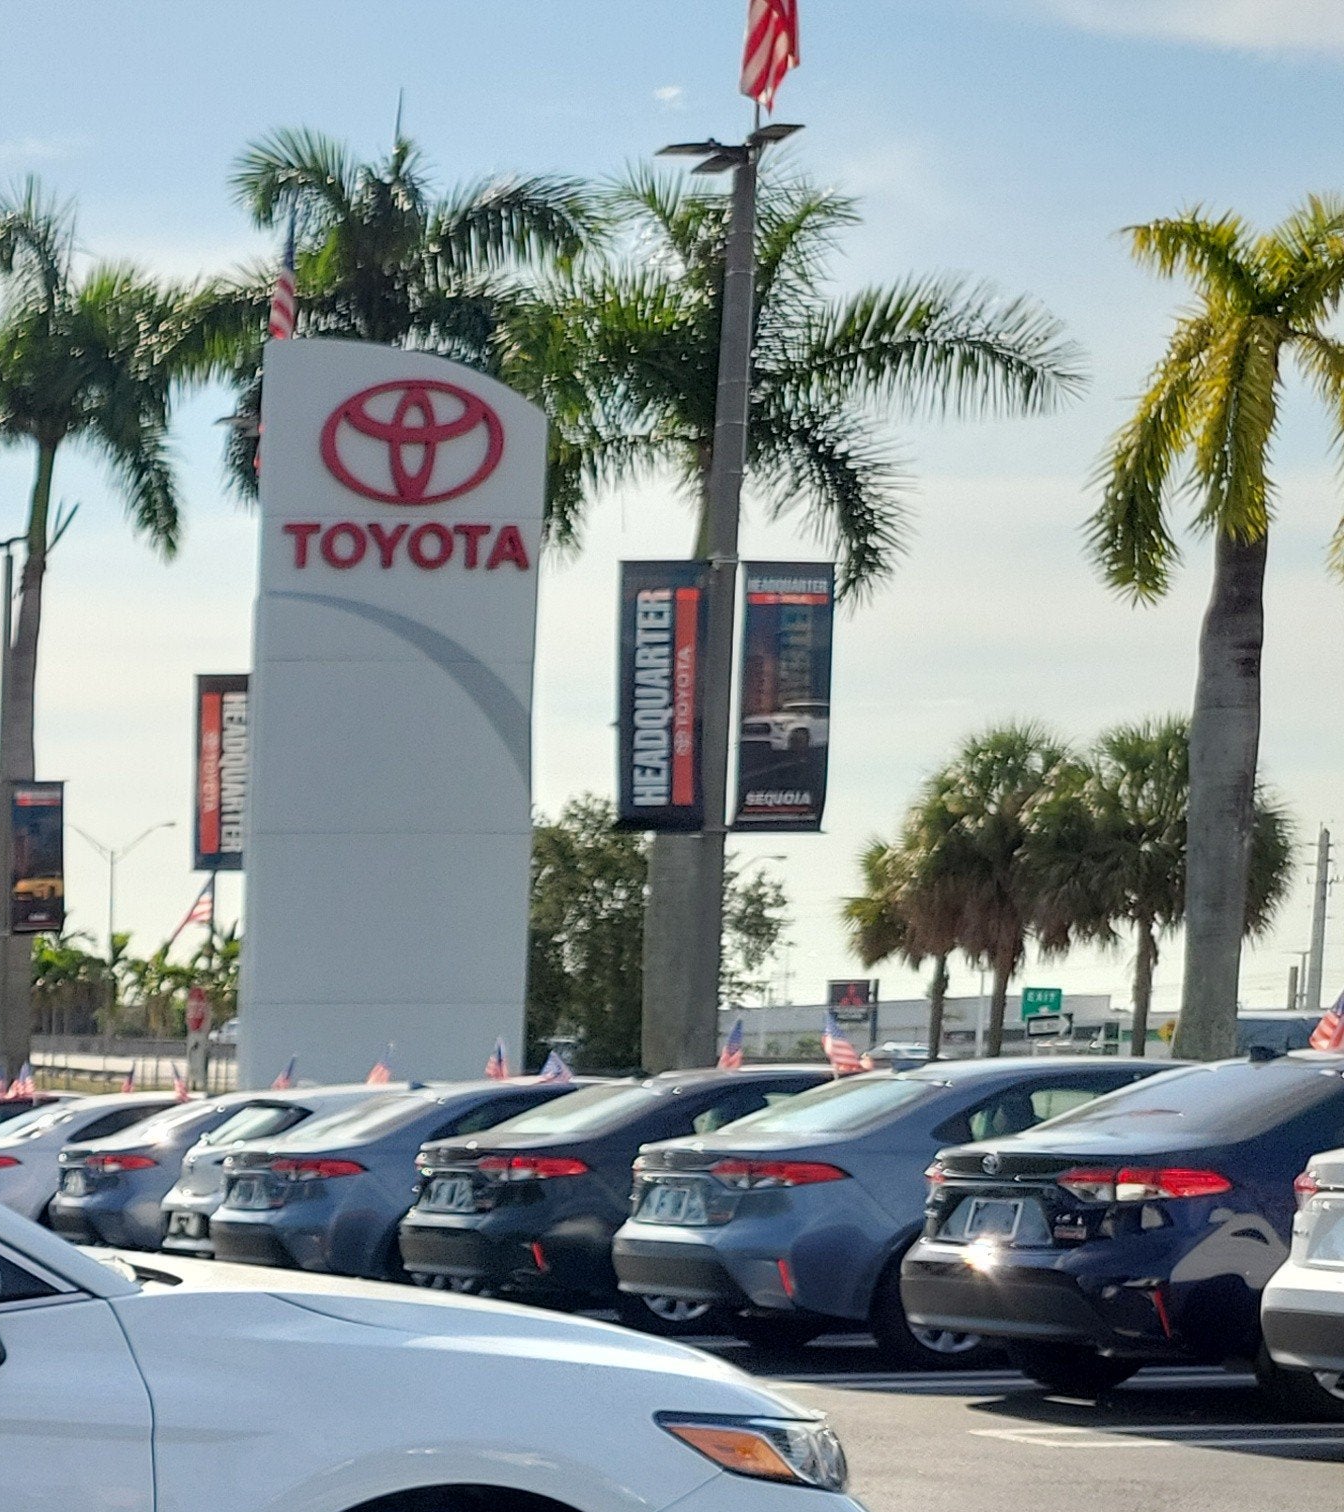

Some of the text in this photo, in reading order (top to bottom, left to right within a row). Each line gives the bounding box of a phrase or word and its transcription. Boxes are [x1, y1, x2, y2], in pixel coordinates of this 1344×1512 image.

[283, 522, 529, 571] TOYOTA
[632, 588, 673, 806] HEADQUARTER
[674, 645, 696, 728] TOYOTA
[219, 691, 249, 853] HEADQUARTER
[743, 789, 812, 807] SEQUOIA
[1026, 991, 1057, 1003] EXIT
